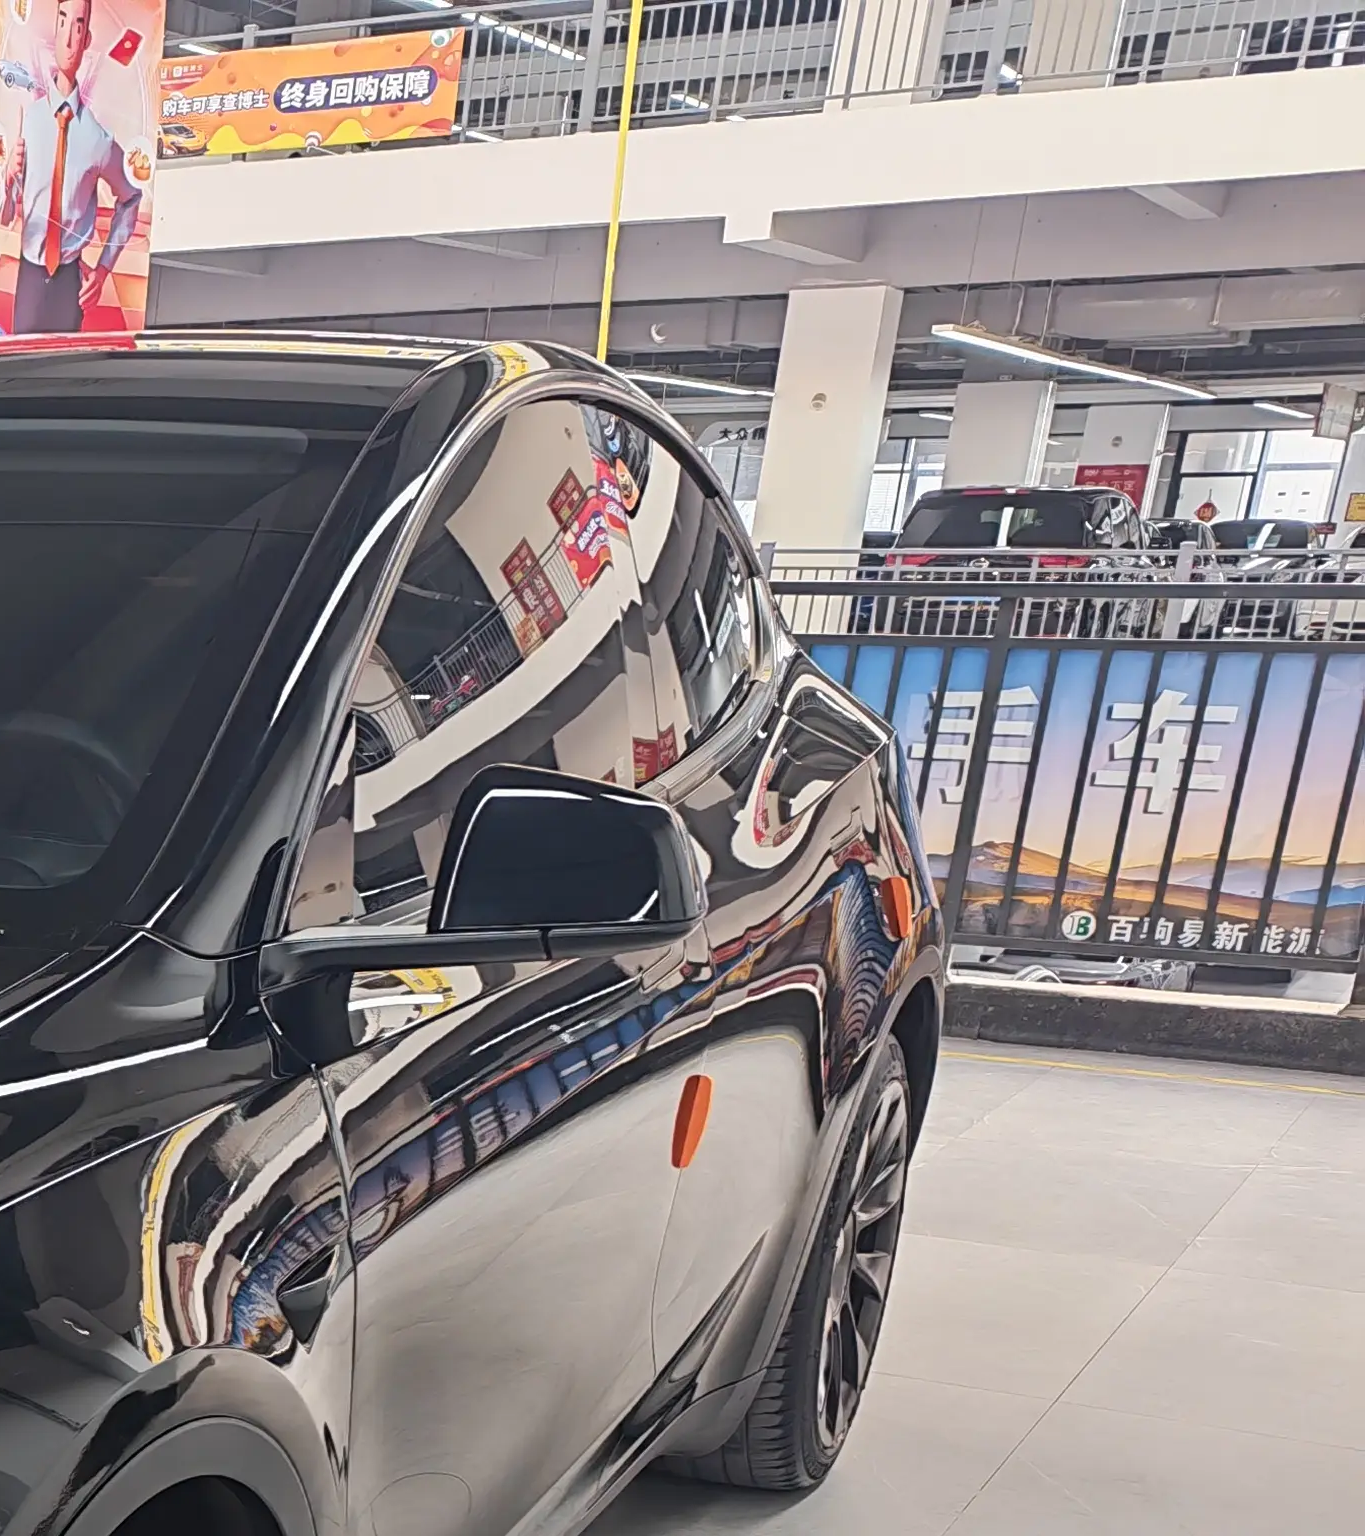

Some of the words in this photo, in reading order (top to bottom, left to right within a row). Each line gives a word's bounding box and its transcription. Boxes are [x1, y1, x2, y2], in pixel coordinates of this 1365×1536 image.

[162, 89, 269, 117] 购车可享查博士
[280, 70, 431, 109] 终身回购保障
